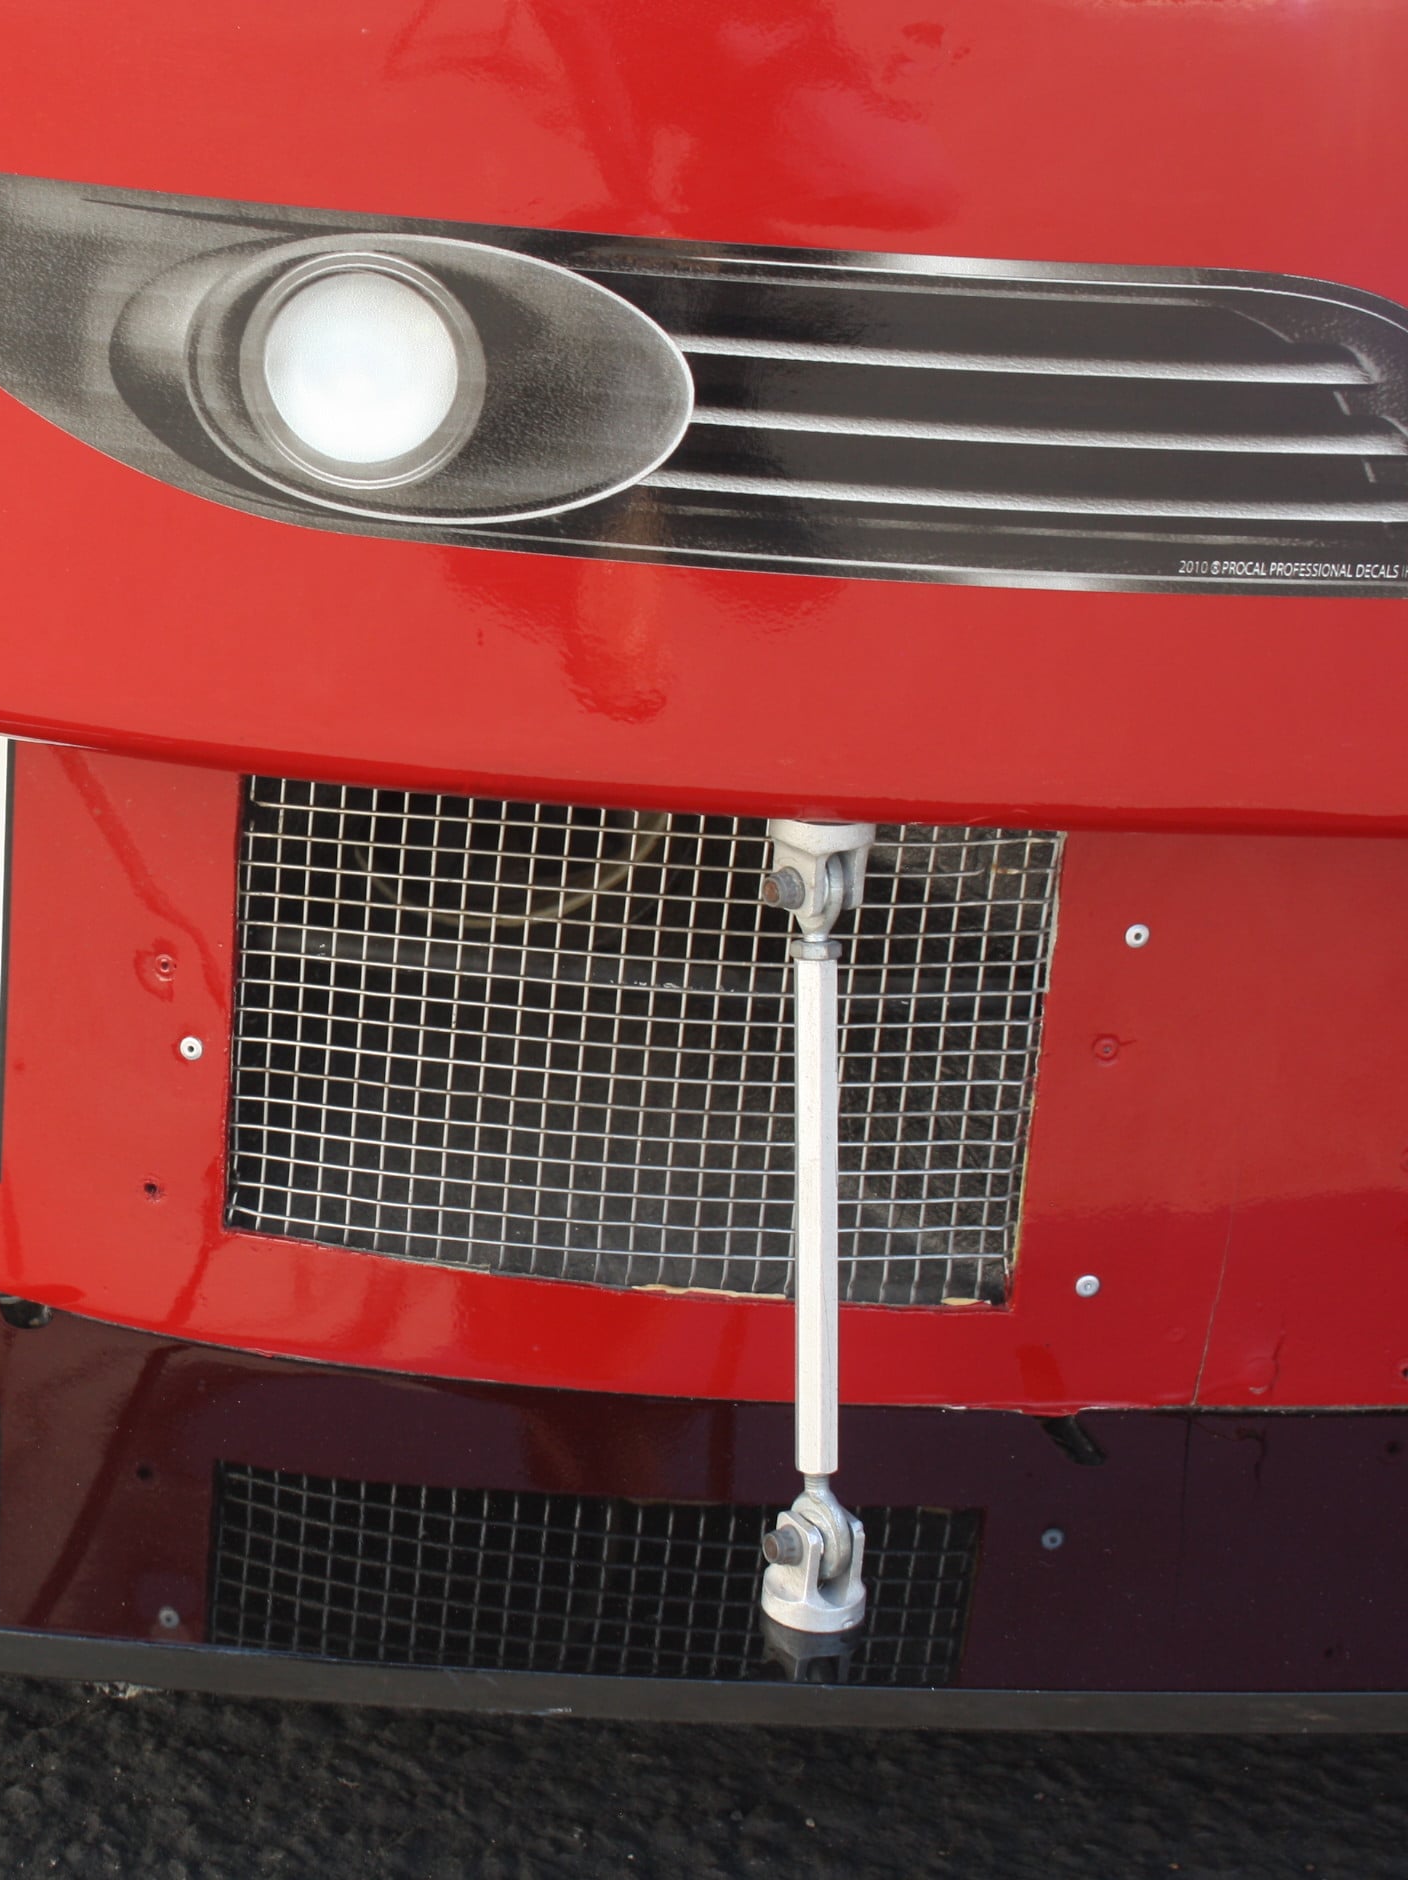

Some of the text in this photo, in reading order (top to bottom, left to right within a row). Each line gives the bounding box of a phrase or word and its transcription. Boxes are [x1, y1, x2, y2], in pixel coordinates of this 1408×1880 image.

[1178, 560, 1209, 574] 2010
[1269, 562, 1352, 578] PROFESSIONAL
[1355, 564, 1399, 578] DECALS
